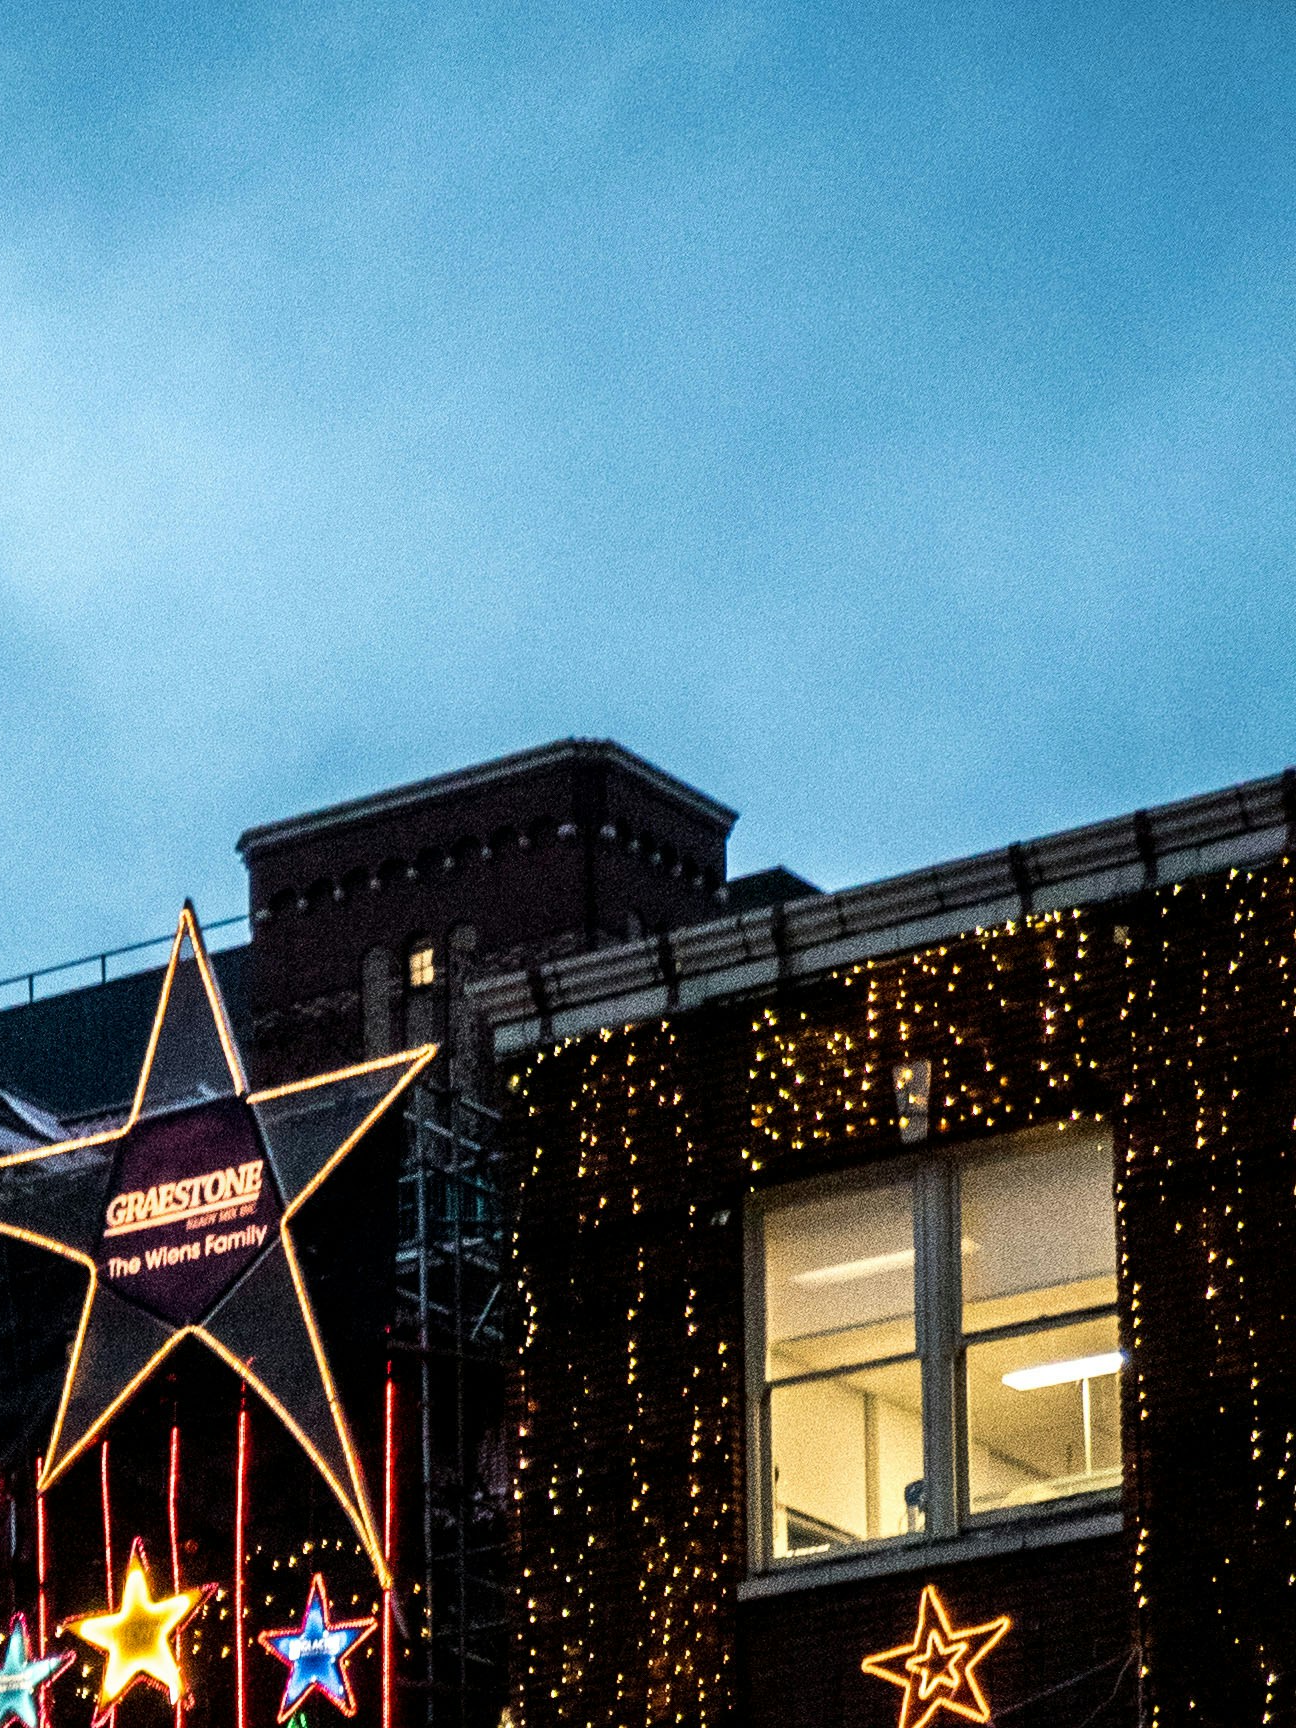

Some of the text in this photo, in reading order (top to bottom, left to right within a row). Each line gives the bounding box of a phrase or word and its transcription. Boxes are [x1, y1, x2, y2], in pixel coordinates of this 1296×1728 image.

[107, 1160, 263, 1226] GRAESTONE
[108, 1256, 141, 1279] The
[205, 1224, 268, 1258] Family
